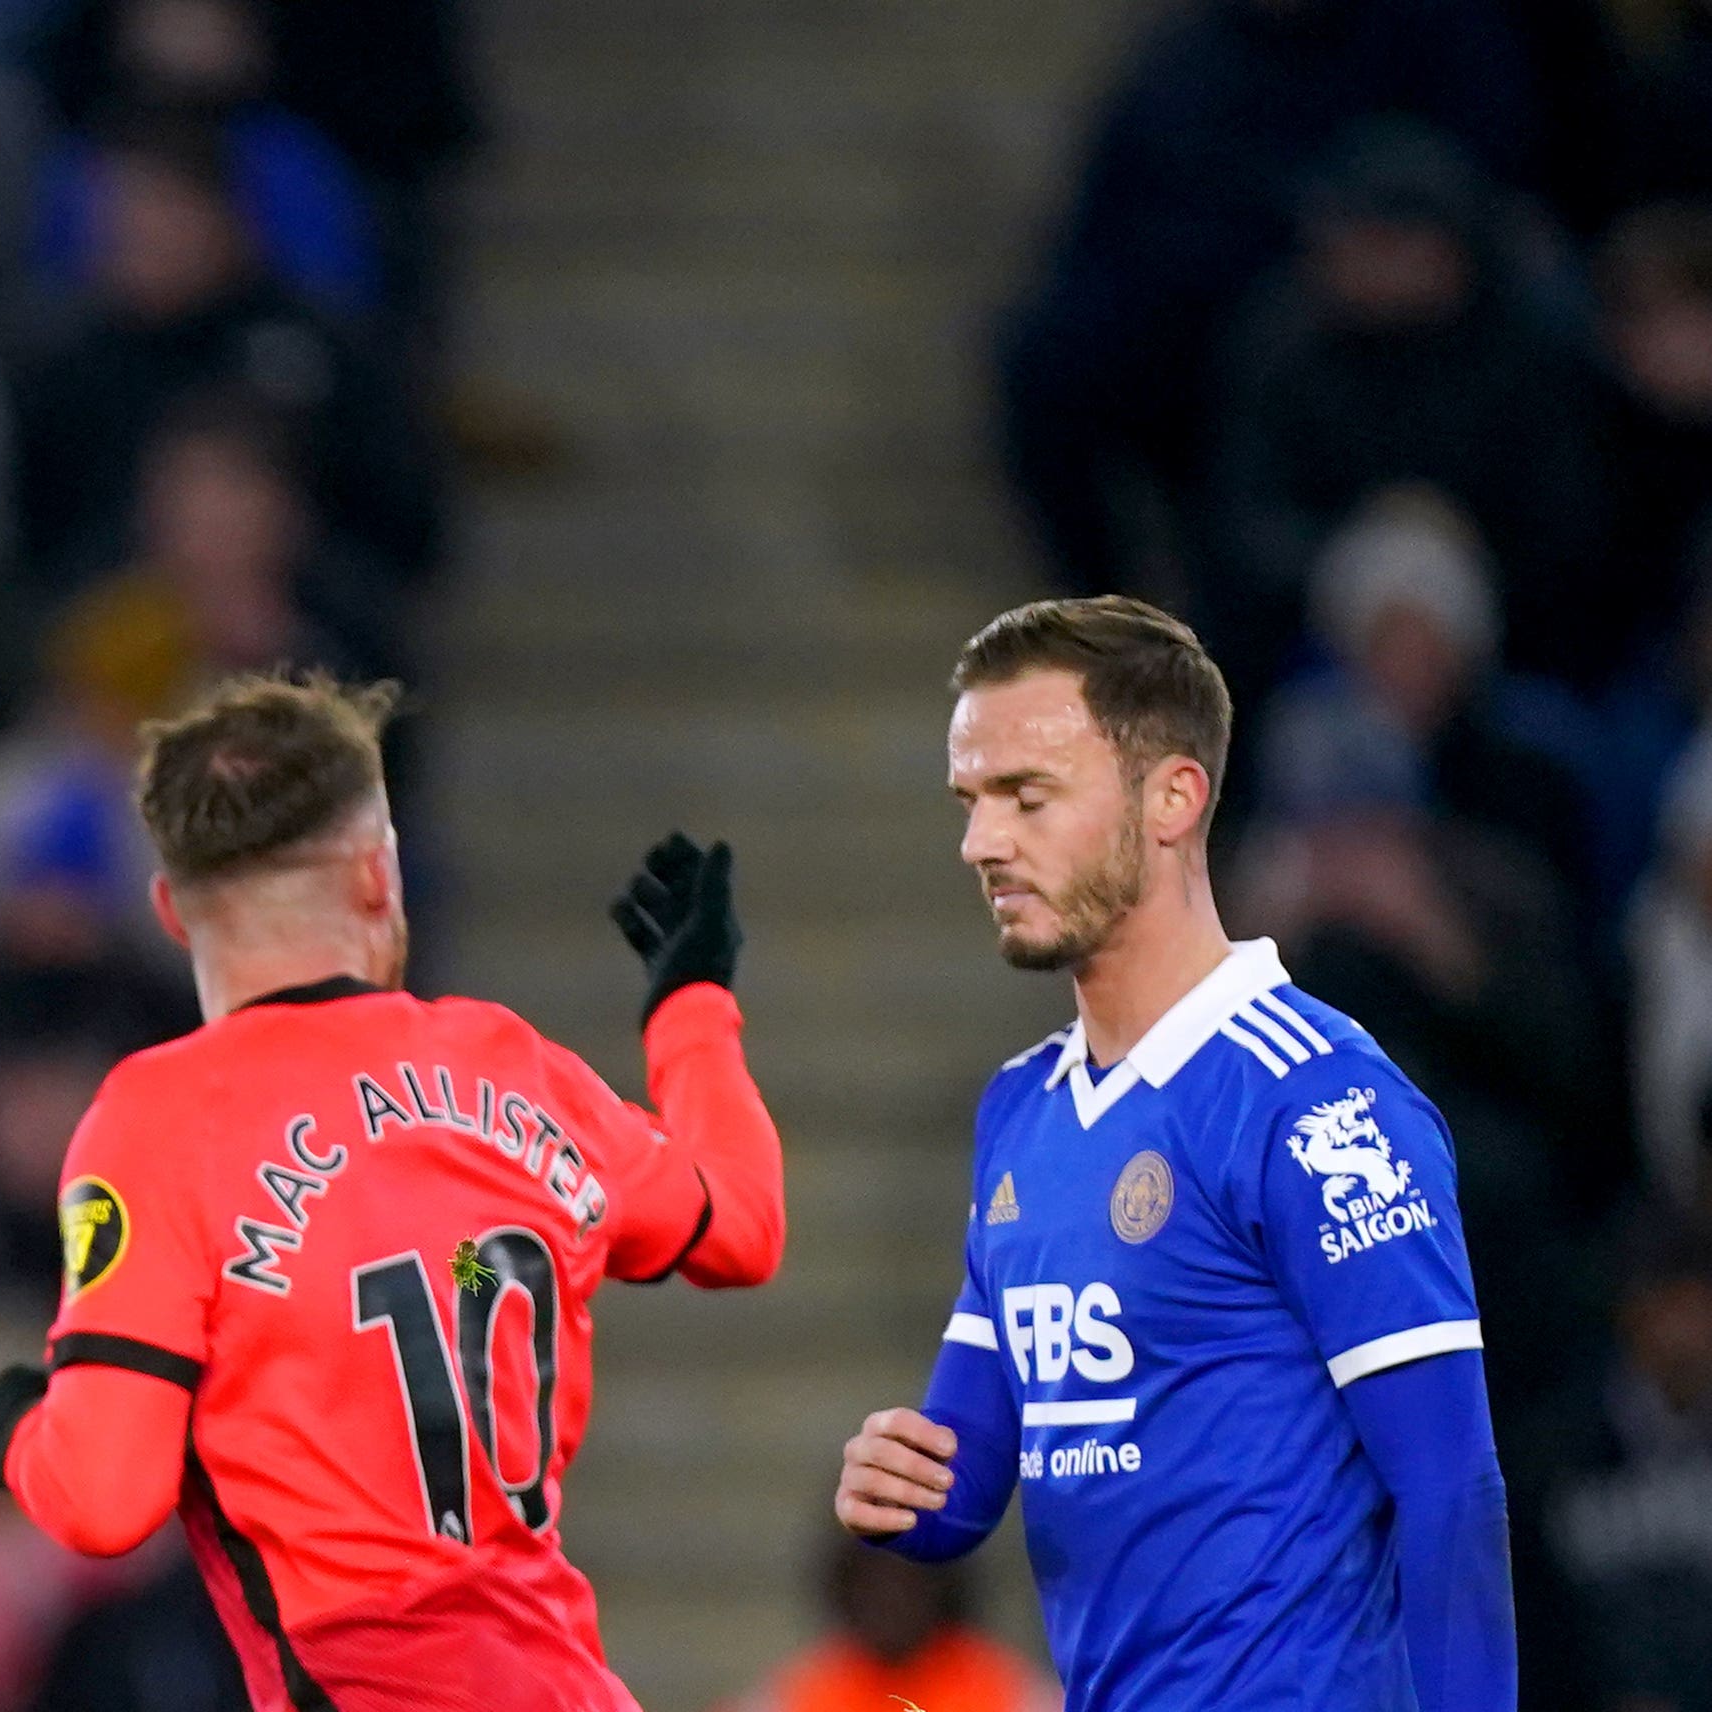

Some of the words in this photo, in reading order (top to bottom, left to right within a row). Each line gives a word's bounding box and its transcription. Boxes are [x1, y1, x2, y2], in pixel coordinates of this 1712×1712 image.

[222, 1112, 348, 1298] MAC
[353, 1061, 608, 1242] ALLISTER
[1346, 1193, 1387, 1220] BIA
[1320, 1199, 1433, 1264] SAIGON
[1003, 1281, 1135, 1385] FBS
[350, 1225, 561, 1547] 10
[1050, 1438, 1142, 1477] online
